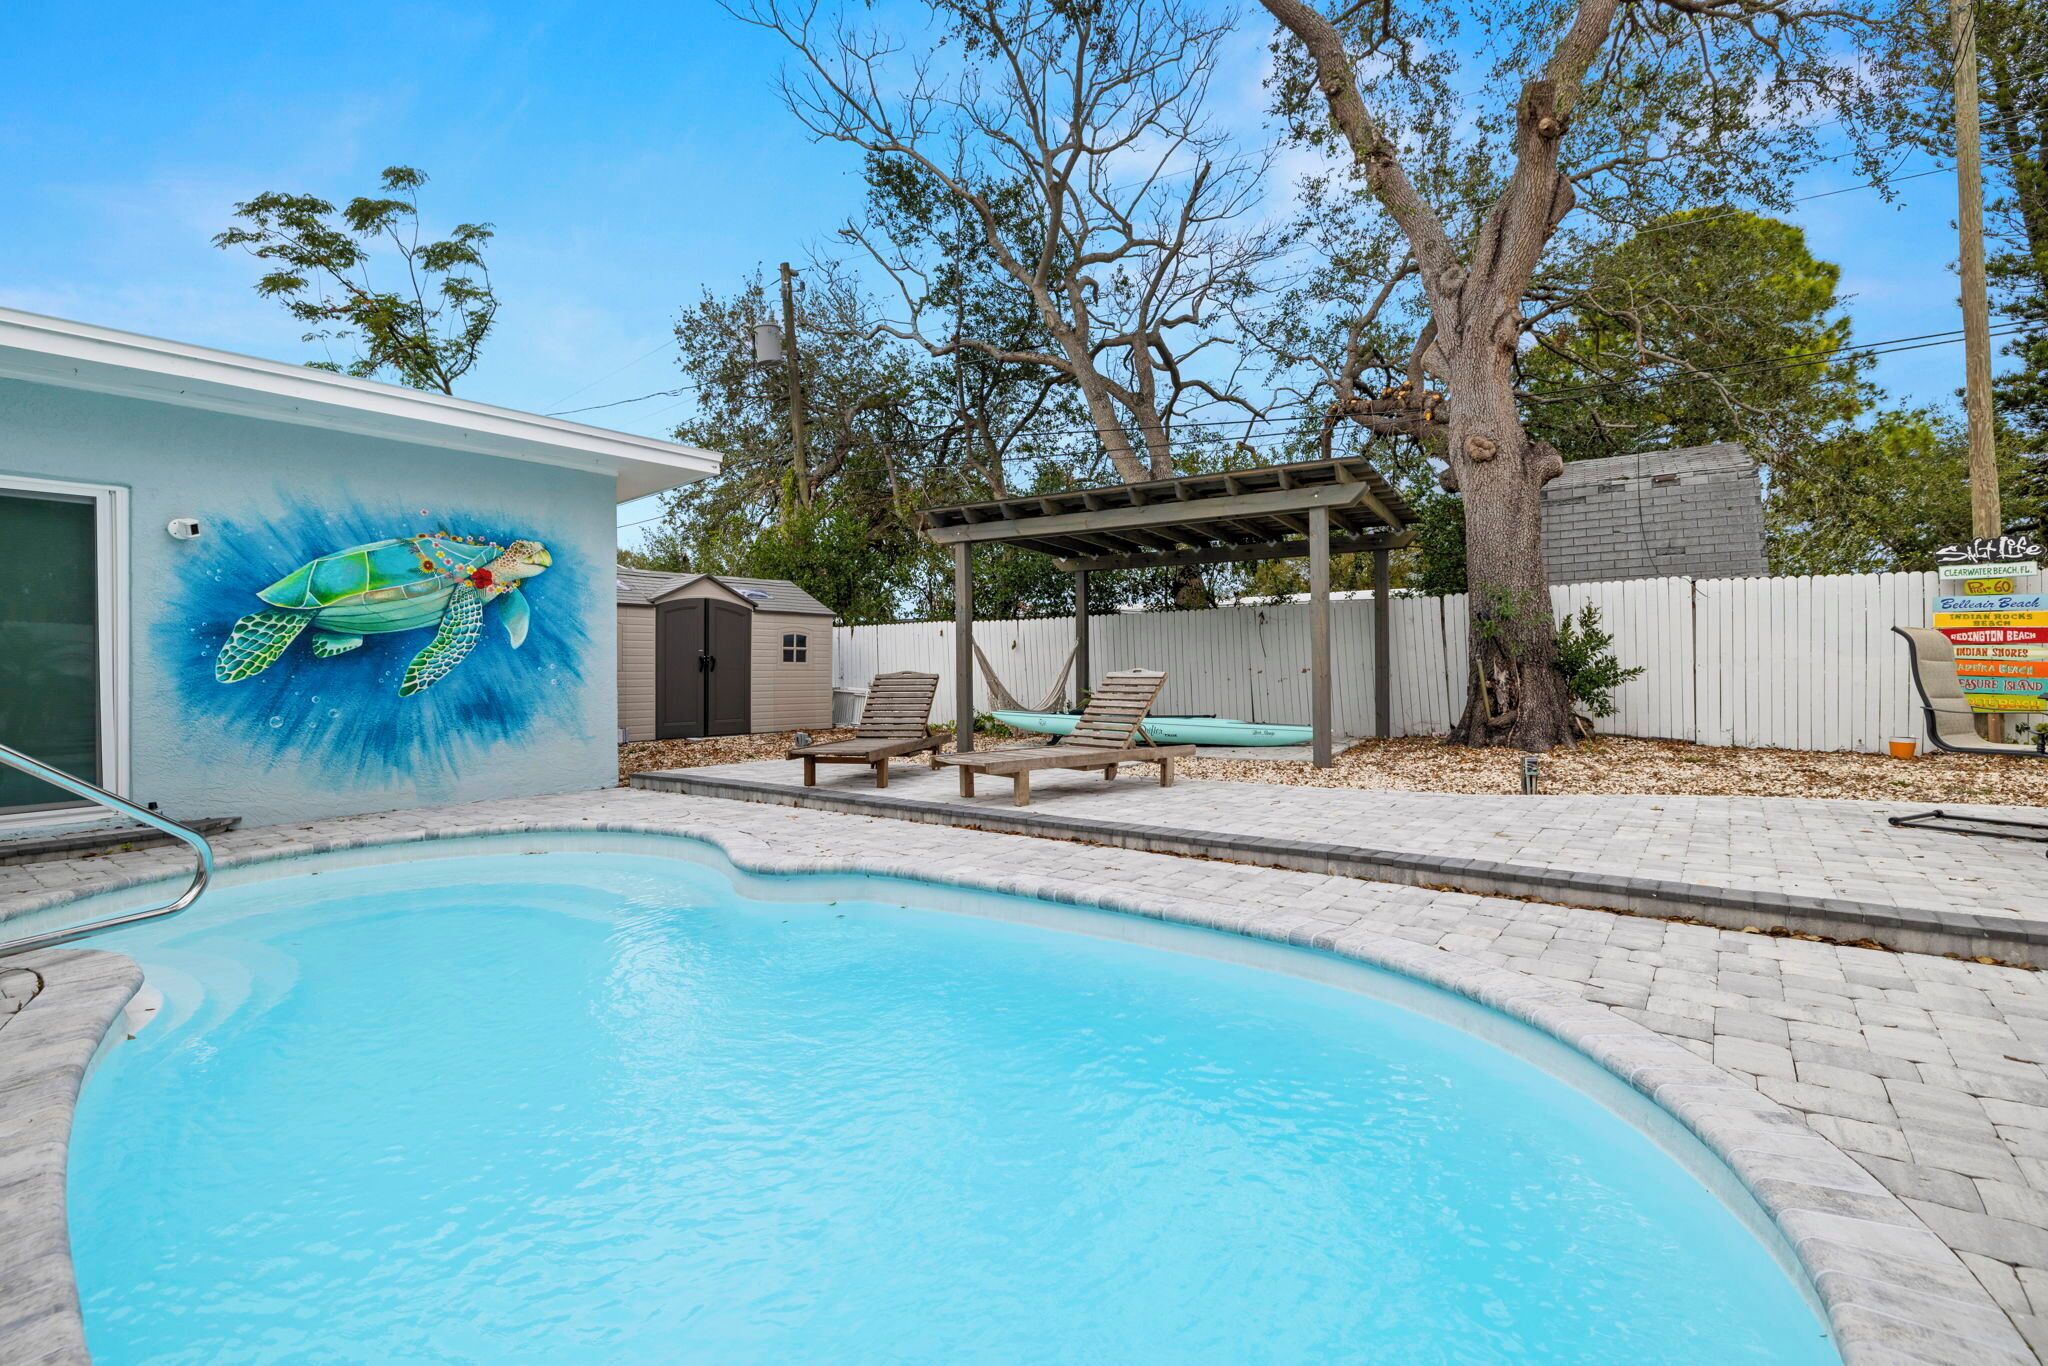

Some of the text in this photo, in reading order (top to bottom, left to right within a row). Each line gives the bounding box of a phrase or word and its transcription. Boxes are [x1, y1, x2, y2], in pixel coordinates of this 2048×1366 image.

[1936, 536, 2042, 563] Salt Life
[1944, 568, 1992, 577] CLEARWATER
[1940, 597, 2040, 609] Belleair Beach
[1950, 630, 2036, 642] REDINGTON BEACH
[1956, 648, 2028, 657] INDIAN SHORES
[1957, 663, 2033, 675] ADEIRA BEACH
[1958, 679, 2043, 691] EASURE ISLAND
